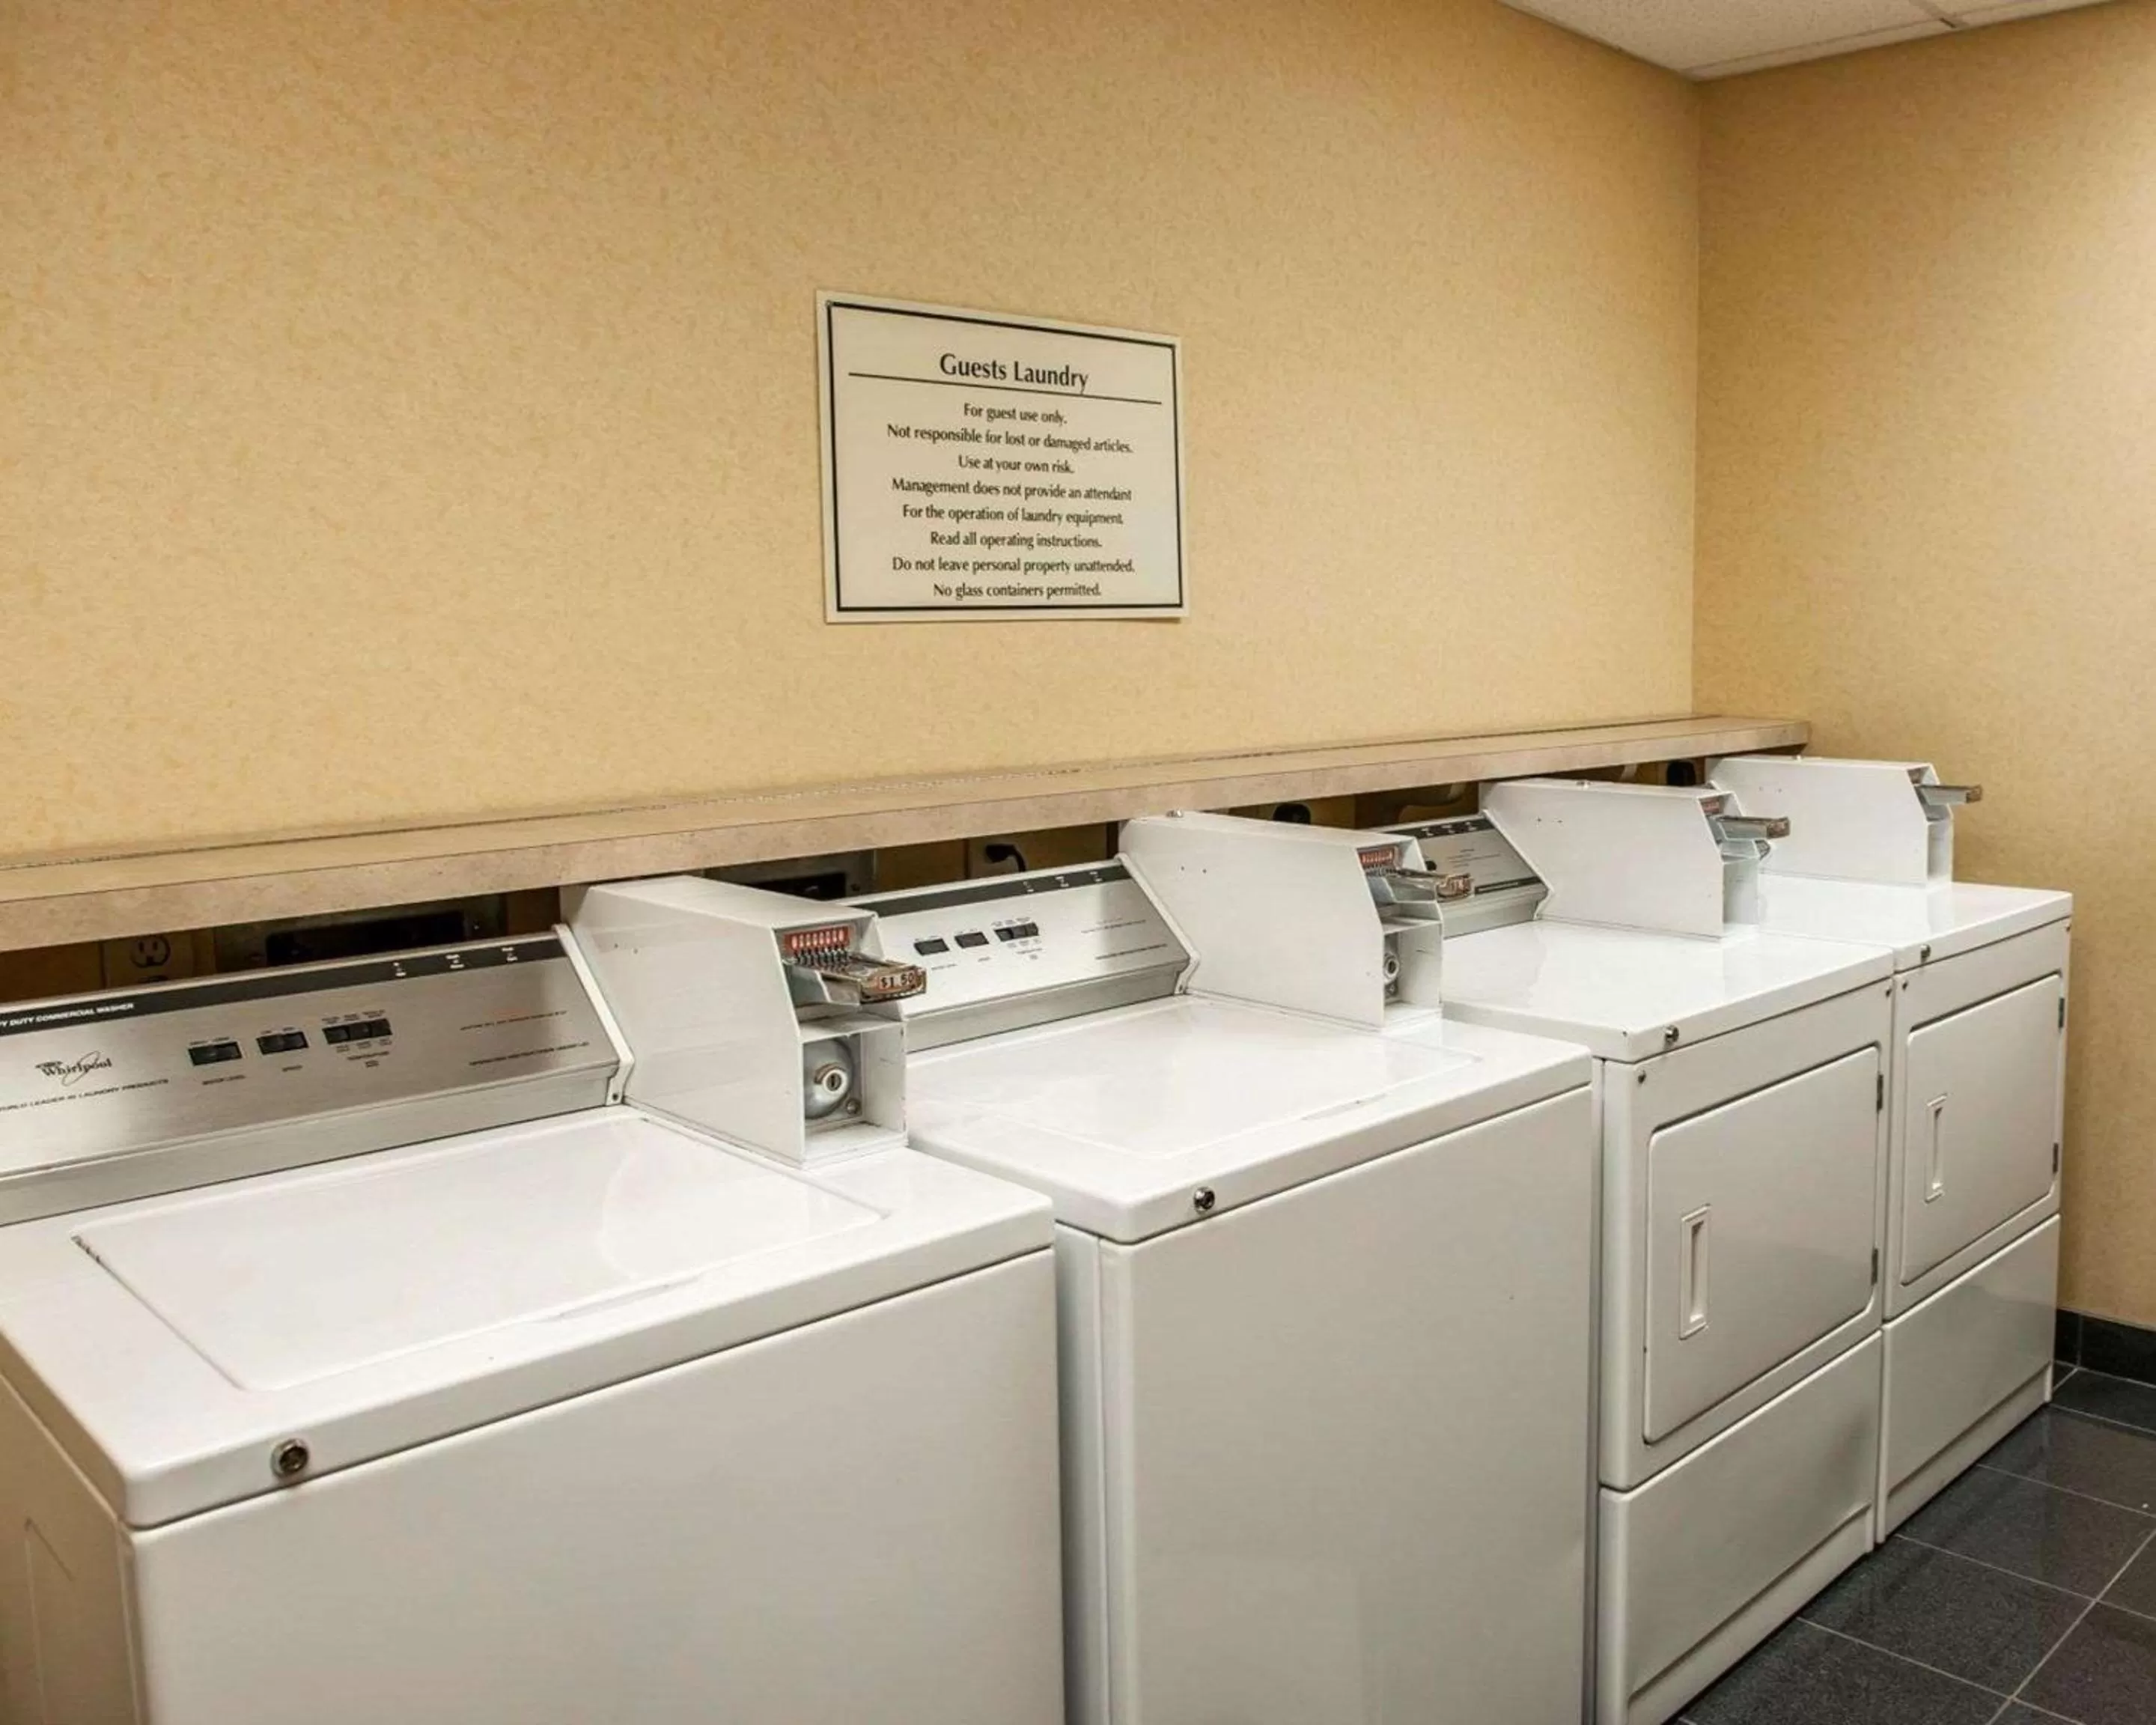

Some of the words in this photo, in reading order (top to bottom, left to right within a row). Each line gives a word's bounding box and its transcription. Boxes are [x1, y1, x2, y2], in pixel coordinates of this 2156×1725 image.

[940, 353, 1007, 380] Guests
[1014, 361, 1088, 395] Laundry
[963, 402, 984, 418] For
[986, 407, 1017, 423] guest
[1019, 411, 1039, 422] use
[1041, 410, 1068, 426] only.
[886, 423, 911, 439] Not
[913, 428, 983, 445] responsible
[984, 429, 1002, 444] for
[1005, 431, 1026, 446] lost
[1028, 436, 1041, 447] or
[1043, 433, 1091, 453] damaged
[957, 454, 981, 469] Use
[982, 457, 994, 470] at
[995, 460, 1022, 475] your
[1024, 462, 1050, 472] own
[892, 477, 971, 496] Management
[972, 480, 1001, 495] does
[1002, 484, 1022, 496] not
[1024, 484, 1067, 501] provide
[1068, 489, 1082, 499] an
[1083, 487, 1132, 501] attendant
[902, 504, 924, 518] For
[925, 504, 945, 520] the
[948, 506, 1005, 523] operation
[1007, 507, 1020, 521] of
[1021, 508, 1062, 526] laundry
[931, 531, 960, 546] Read
[962, 531, 977, 546] all
[979, 532, 1035, 550] operating
[1036, 532, 1103, 547] instructions.
[892, 556, 913, 571] Do
[915, 559, 935, 571] not
[938, 556, 969, 571] leave
[972, 557, 1021, 575] personal
[1023, 559, 1071, 576] property
[1074, 559, 1135, 573] unattended.
[934, 583, 953, 597] No
[954, 582, 984, 601] glass
[986, 582, 1044, 597] containers
[1046, 583, 1101, 600] permitted.
[10, 1017, 34, 1026] DUTY
[36, 1008, 95, 1023] COMMERCIAL
[40, 1054, 113, 1081] Whirlpool
